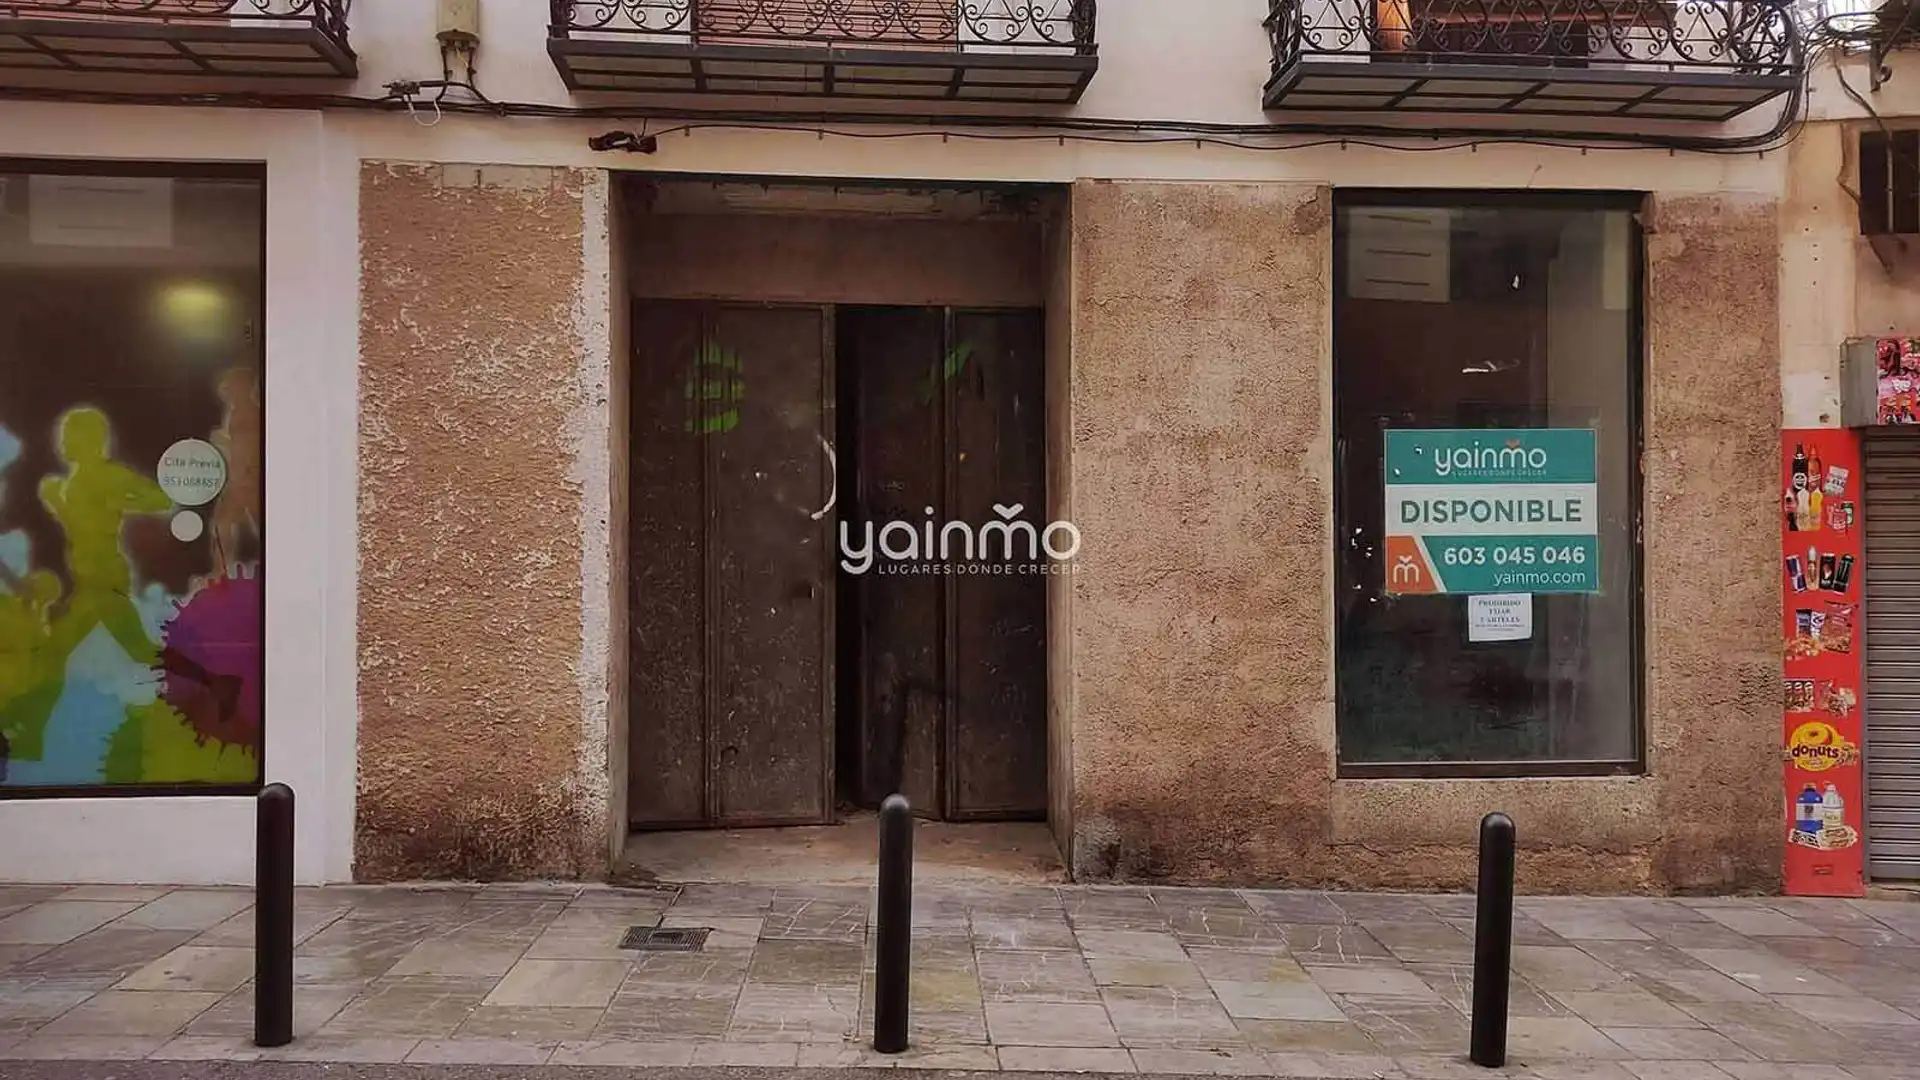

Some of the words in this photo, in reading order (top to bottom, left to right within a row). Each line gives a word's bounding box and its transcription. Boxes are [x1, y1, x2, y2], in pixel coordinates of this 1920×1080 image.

[1434, 439, 1547, 476] yainmo
[1401, 499, 1582, 524] DISPONIBLE
[1444, 547, 1486, 565] 603
[1493, 547, 1536, 565] 045
[1542, 547, 1586, 565] 046
[1492, 570, 1586, 587] yainmo.com
[1791, 743, 1840, 758] donuts
